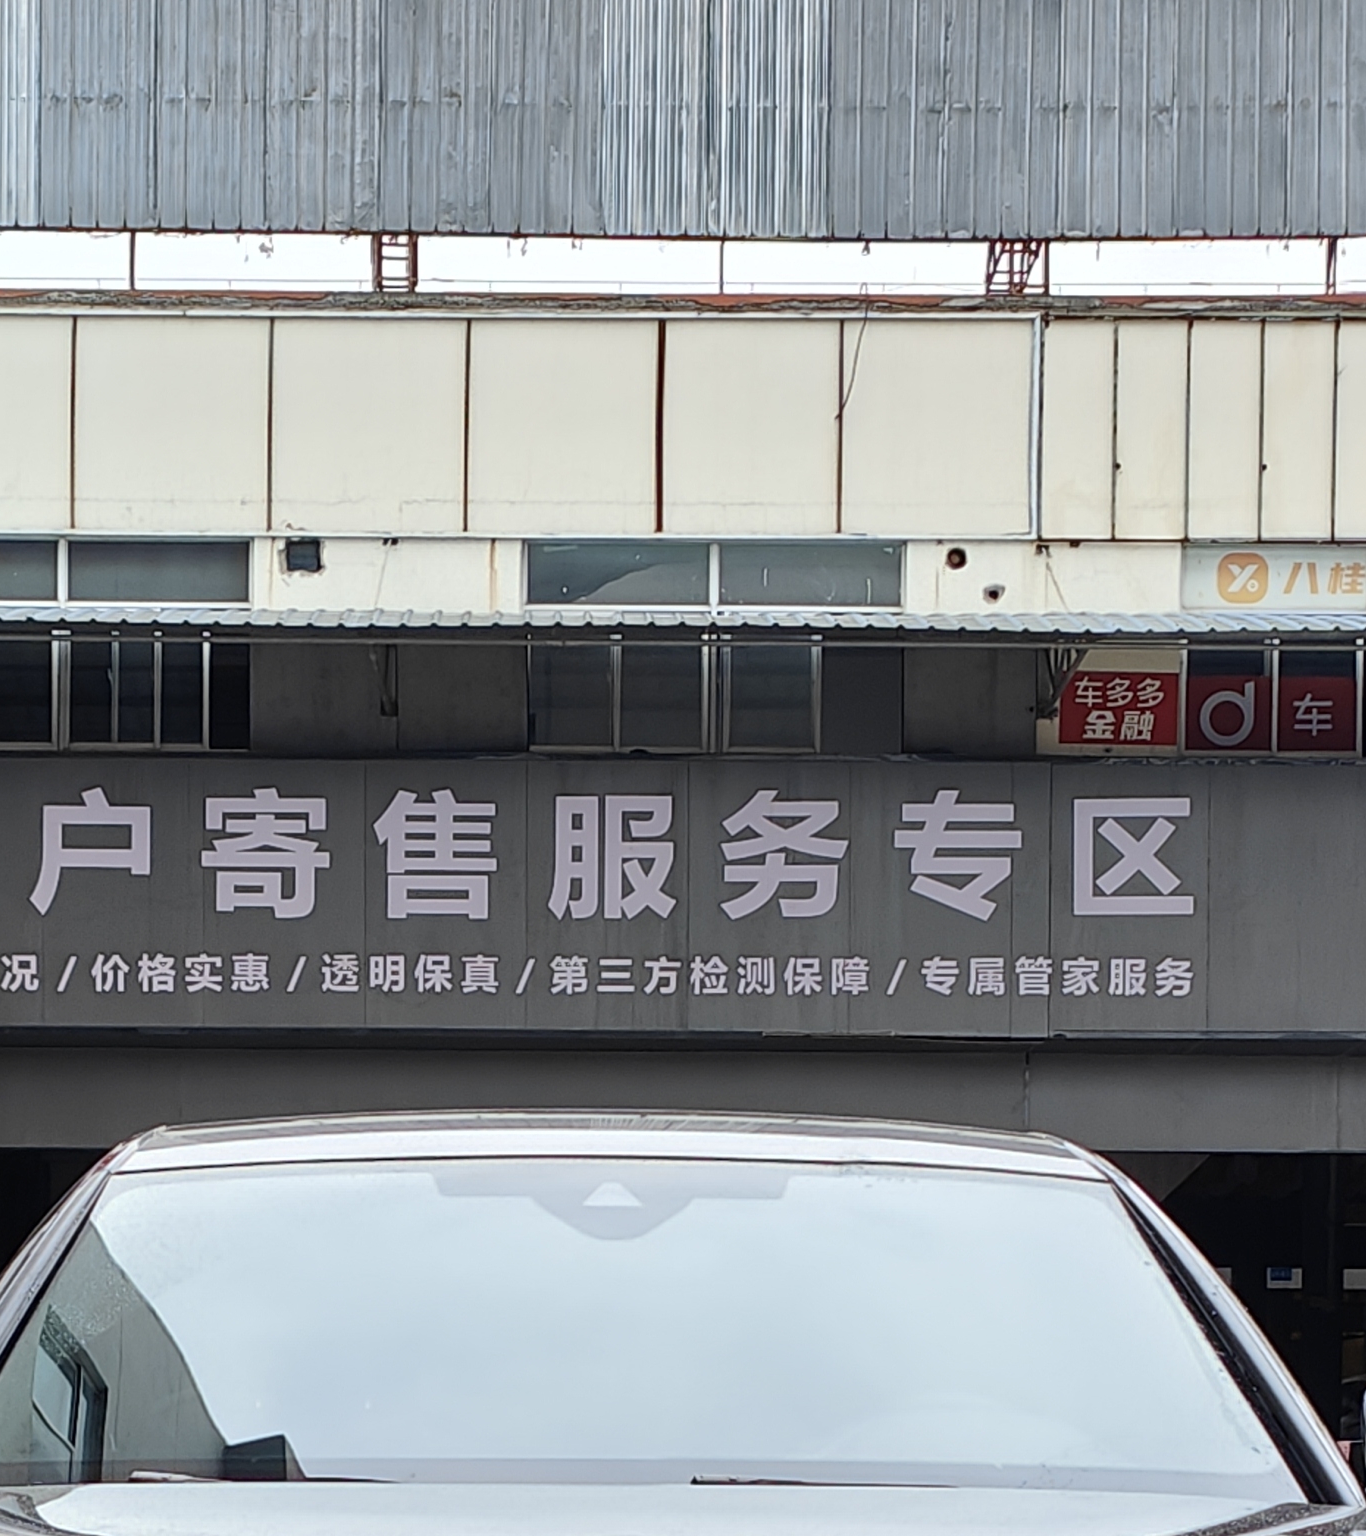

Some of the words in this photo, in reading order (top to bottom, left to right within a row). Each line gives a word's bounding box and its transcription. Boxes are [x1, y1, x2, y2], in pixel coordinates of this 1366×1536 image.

[1074, 676, 1164, 708] 车多多
[1082, 710, 1154, 742] 金融
